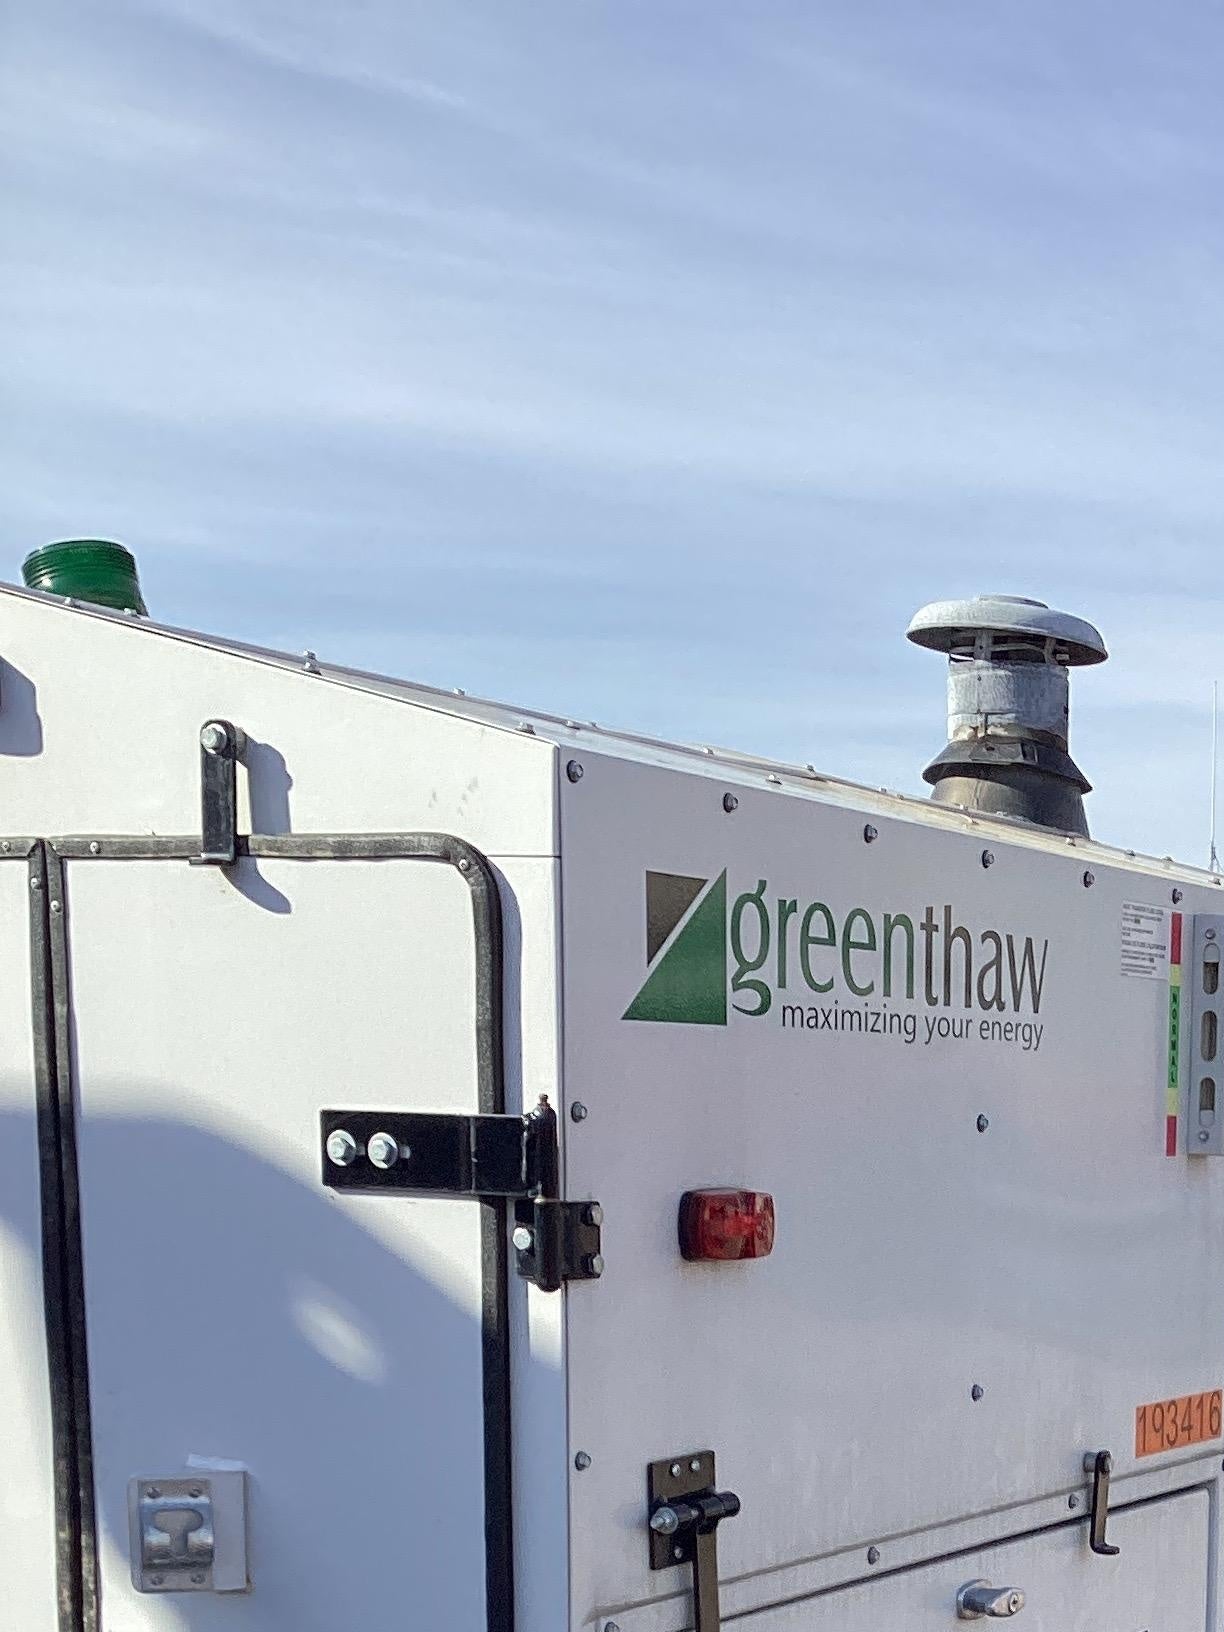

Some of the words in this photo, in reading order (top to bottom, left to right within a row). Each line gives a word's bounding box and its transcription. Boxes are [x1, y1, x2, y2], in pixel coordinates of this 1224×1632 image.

[730, 879, 1048, 1016] greenthaw
[782, 1000, 917, 1043] maximizing
[924, 1015, 972, 1045] your
[979, 1019, 1043, 1051] energy
[1170, 992, 1178, 1083] NORMAL
[1139, 1391, 1221, 1452] 193416
